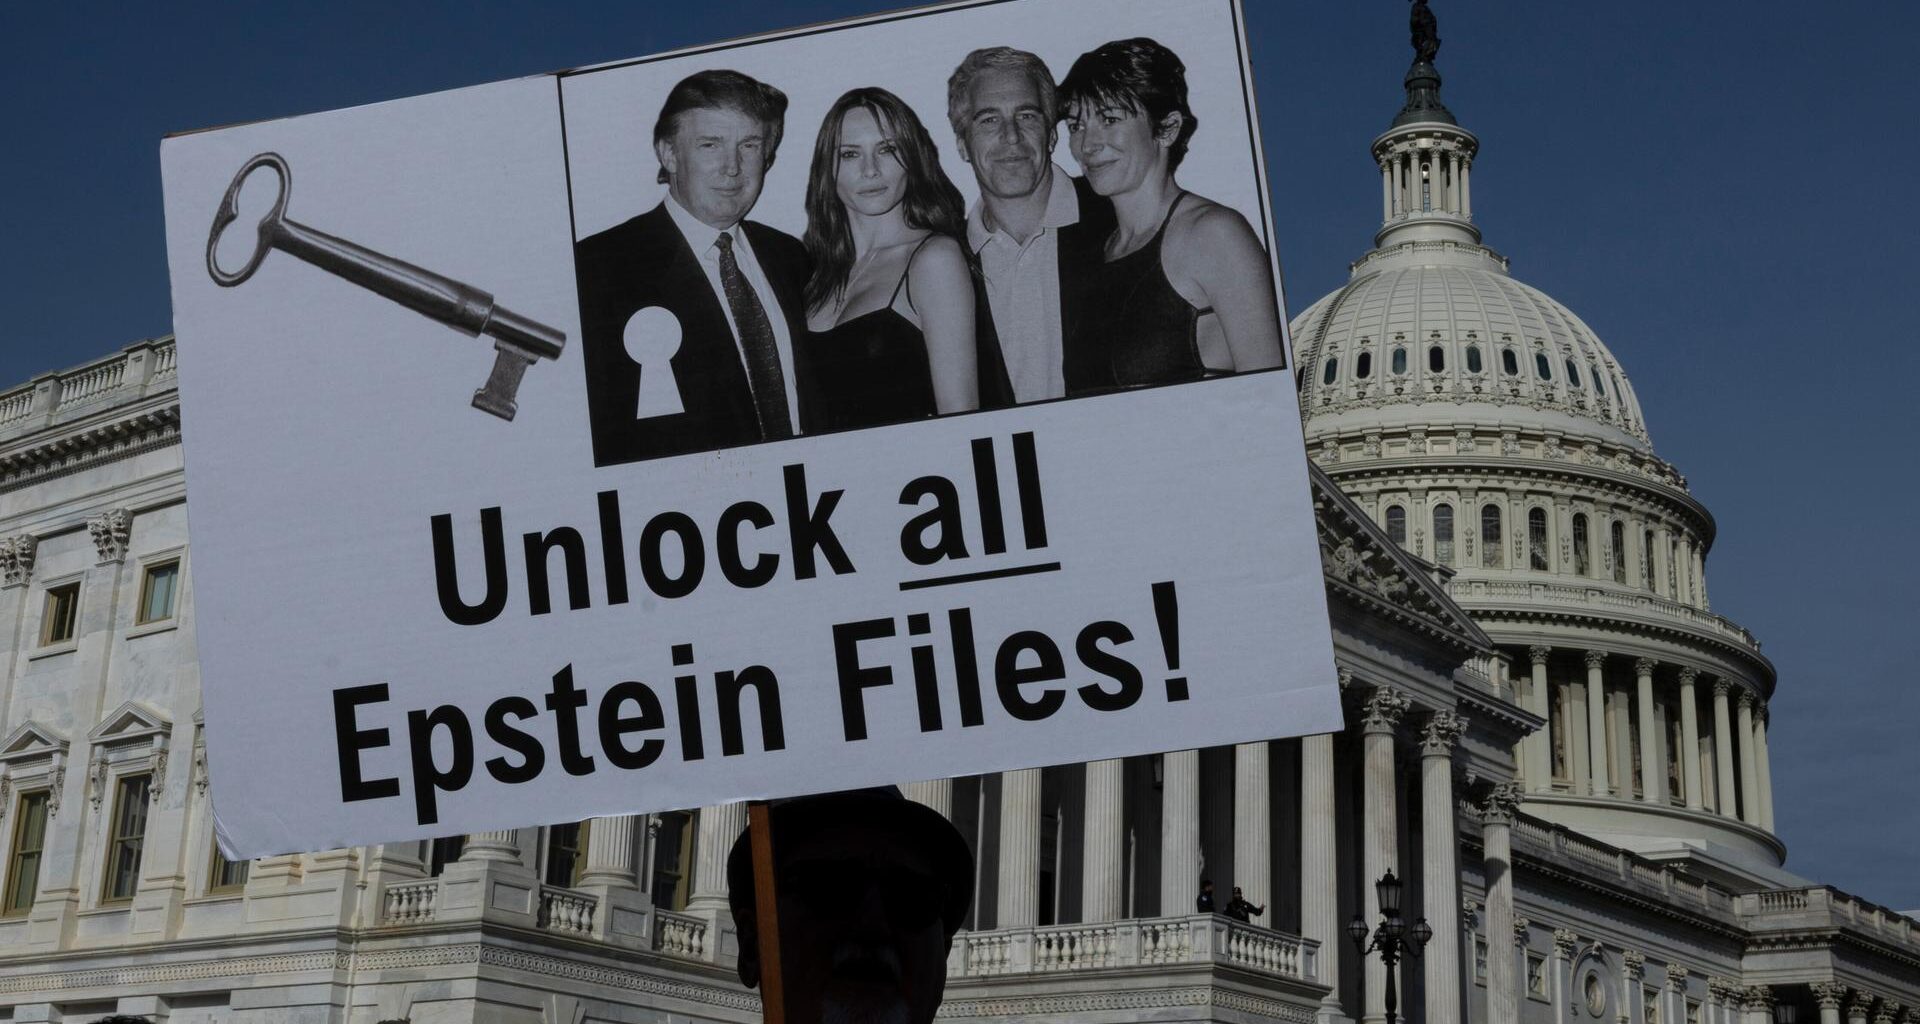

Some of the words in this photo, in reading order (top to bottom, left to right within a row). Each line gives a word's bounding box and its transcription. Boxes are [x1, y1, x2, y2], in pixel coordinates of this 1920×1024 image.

[431, 464, 856, 625] Unlock
[899, 432, 1049, 565] all
[333, 644, 785, 825] Epstein
[832, 581, 1190, 742] Files!
